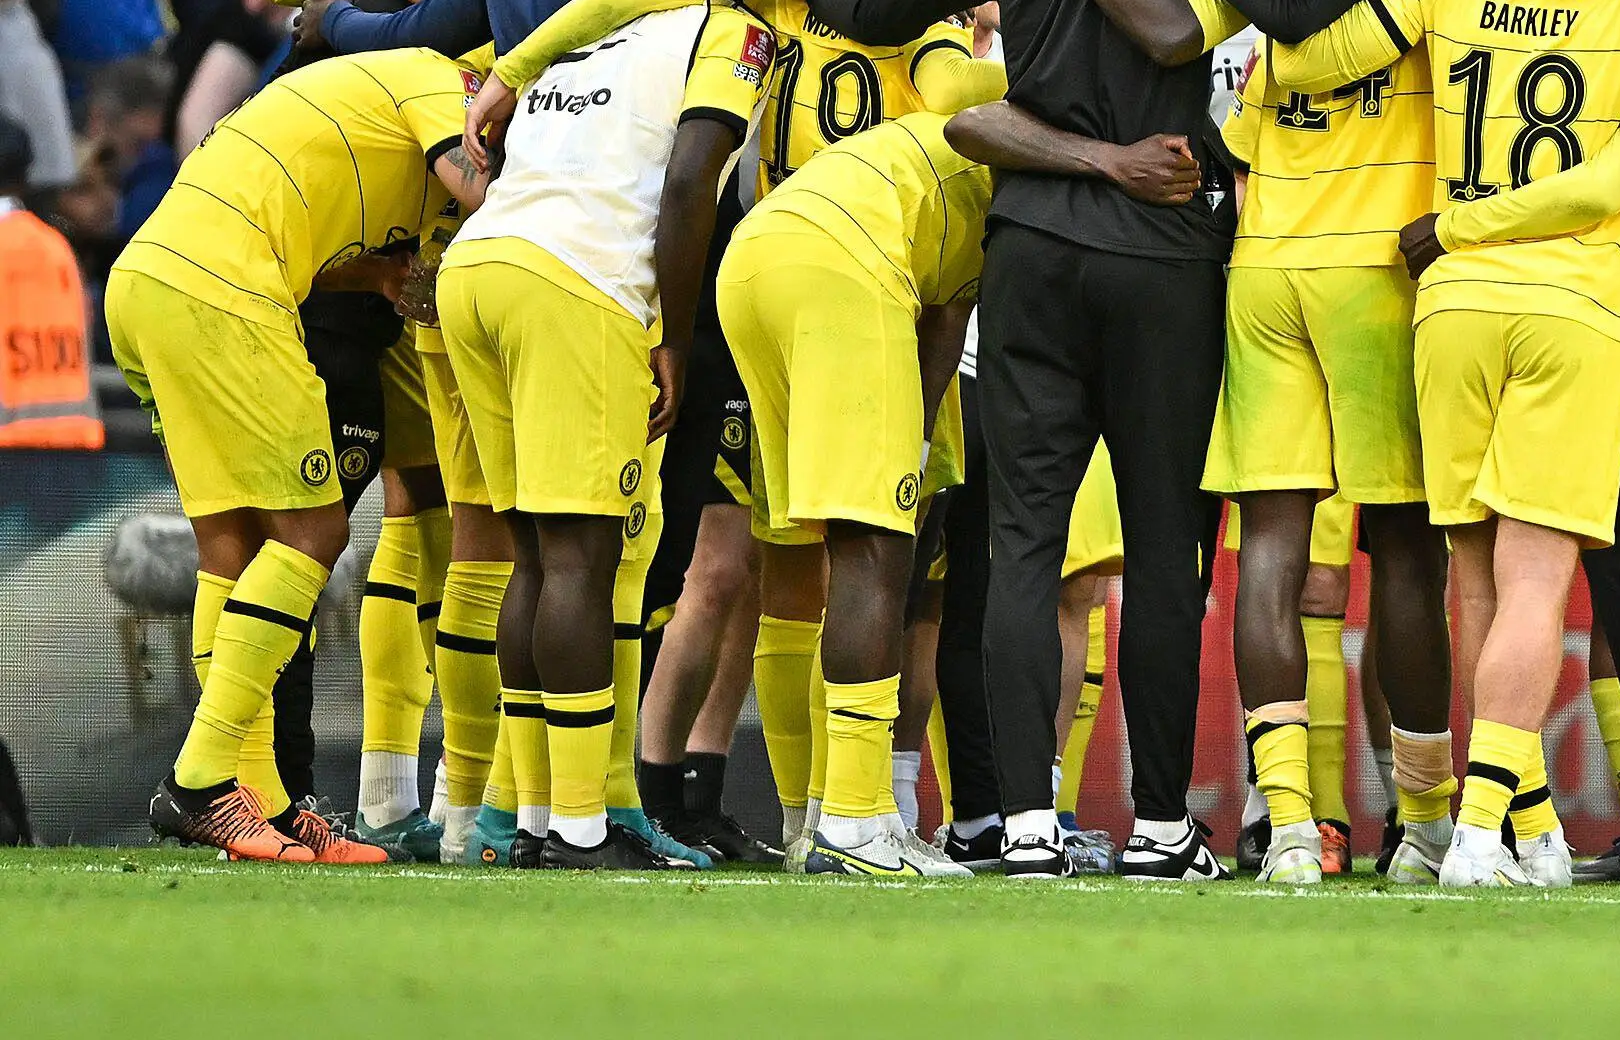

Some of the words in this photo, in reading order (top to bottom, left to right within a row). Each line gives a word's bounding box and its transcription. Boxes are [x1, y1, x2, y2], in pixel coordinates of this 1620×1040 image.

[1479, 0, 1579, 37] BARKLEY
[1448, 47, 1587, 203] 18
[342, 423, 380, 443] trivago
[1019, 834, 1040, 845] NIKE
[1127, 836, 1147, 847] NIKE
